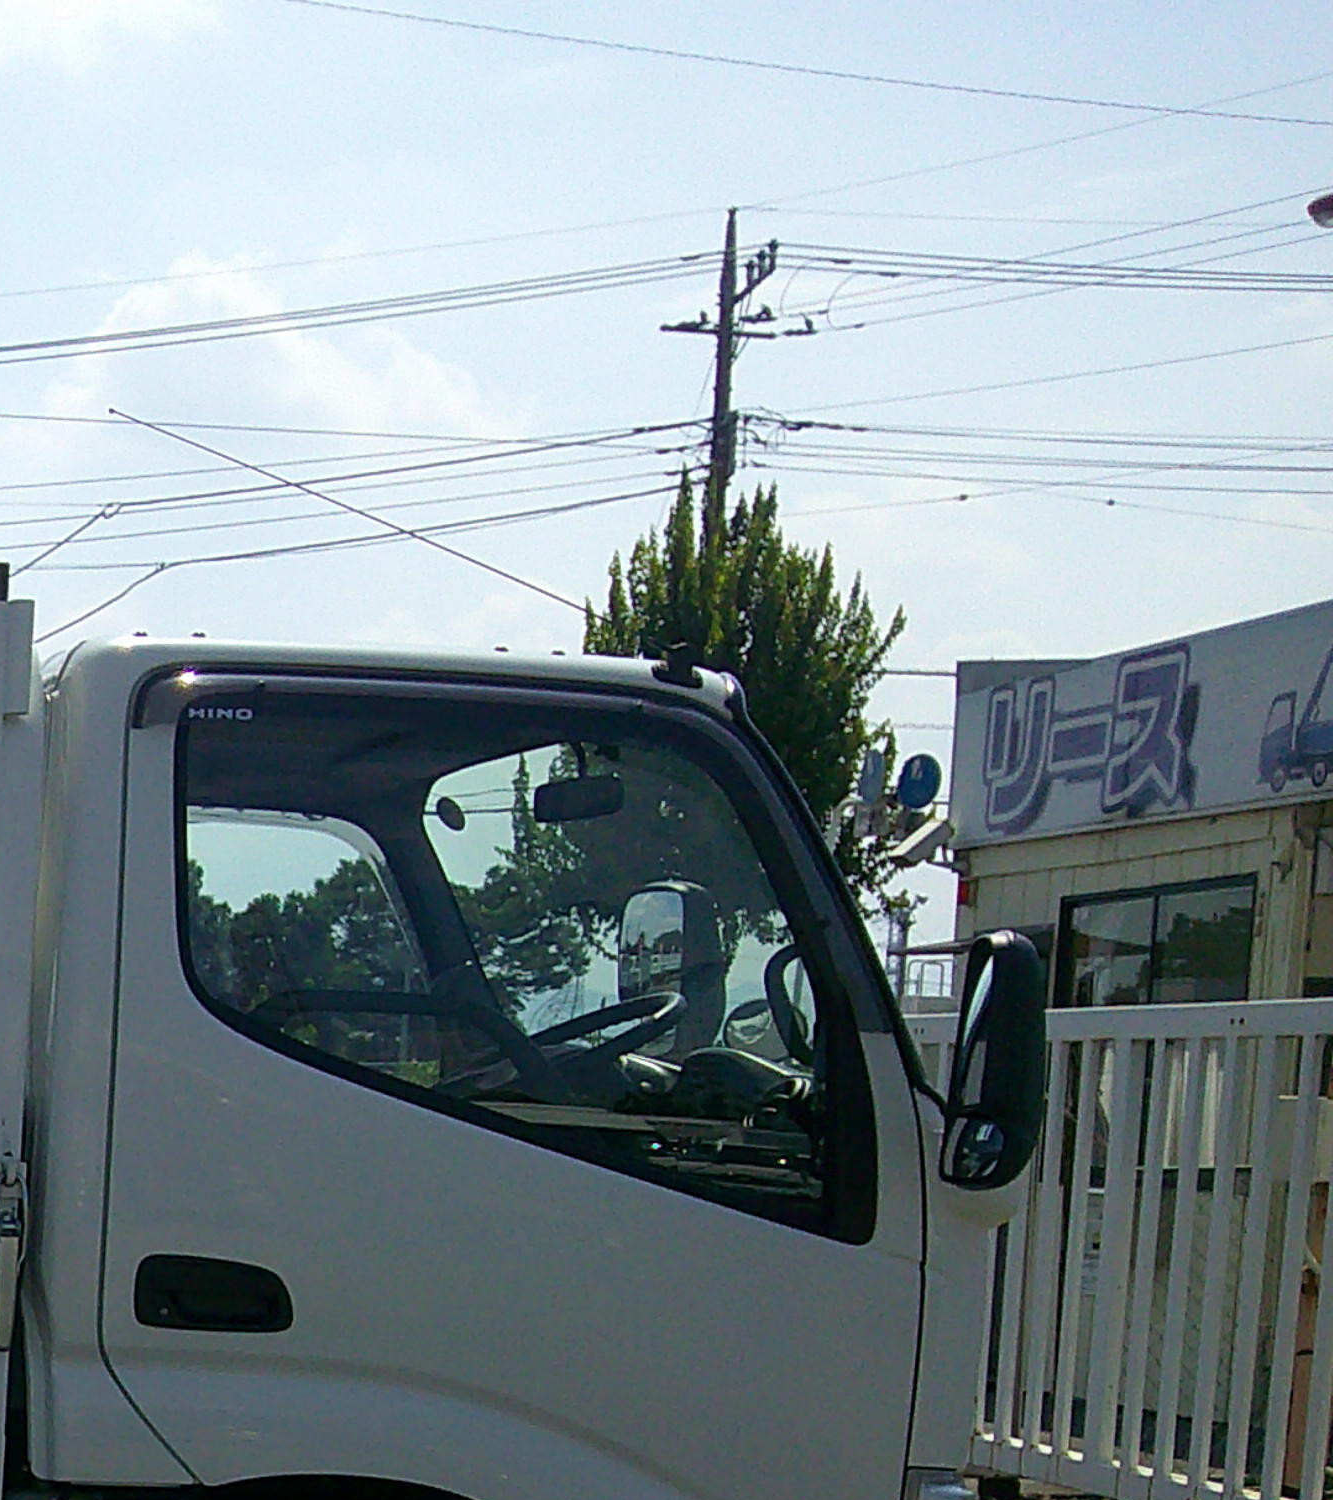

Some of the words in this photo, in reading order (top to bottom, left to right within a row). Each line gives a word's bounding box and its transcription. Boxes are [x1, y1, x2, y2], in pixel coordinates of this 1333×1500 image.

[188, 707, 253, 721] HINO
[985, 643, 1195, 832] リース
